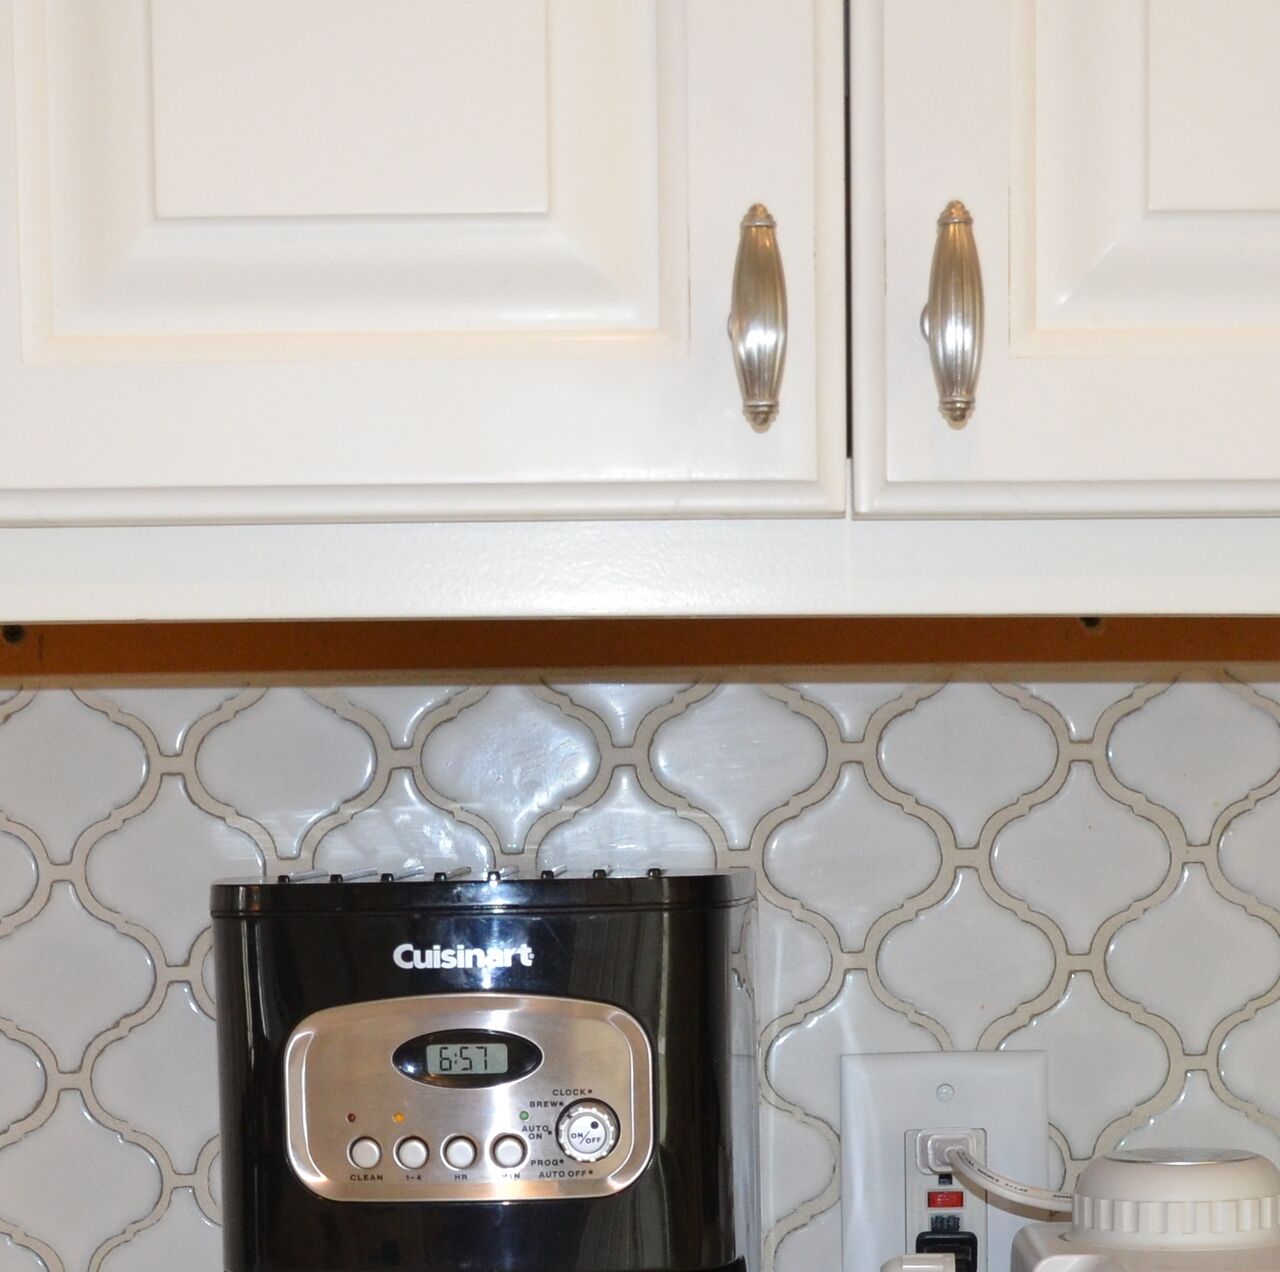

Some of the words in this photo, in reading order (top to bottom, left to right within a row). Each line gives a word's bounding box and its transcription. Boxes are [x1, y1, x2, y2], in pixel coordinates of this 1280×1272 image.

[393, 944, 534, 969] Cuisinart
[439, 1046, 487, 1071] 6:57
[552, 1088, 586, 1096] CLOCK
[521, 1125, 549, 1133] AUTO
[530, 1159, 558, 1167] PROG
[350, 1174, 383, 1182] CLEAN
[454, 1174, 468, 1182] HR
[539, 1171, 565, 1179] AUTO
